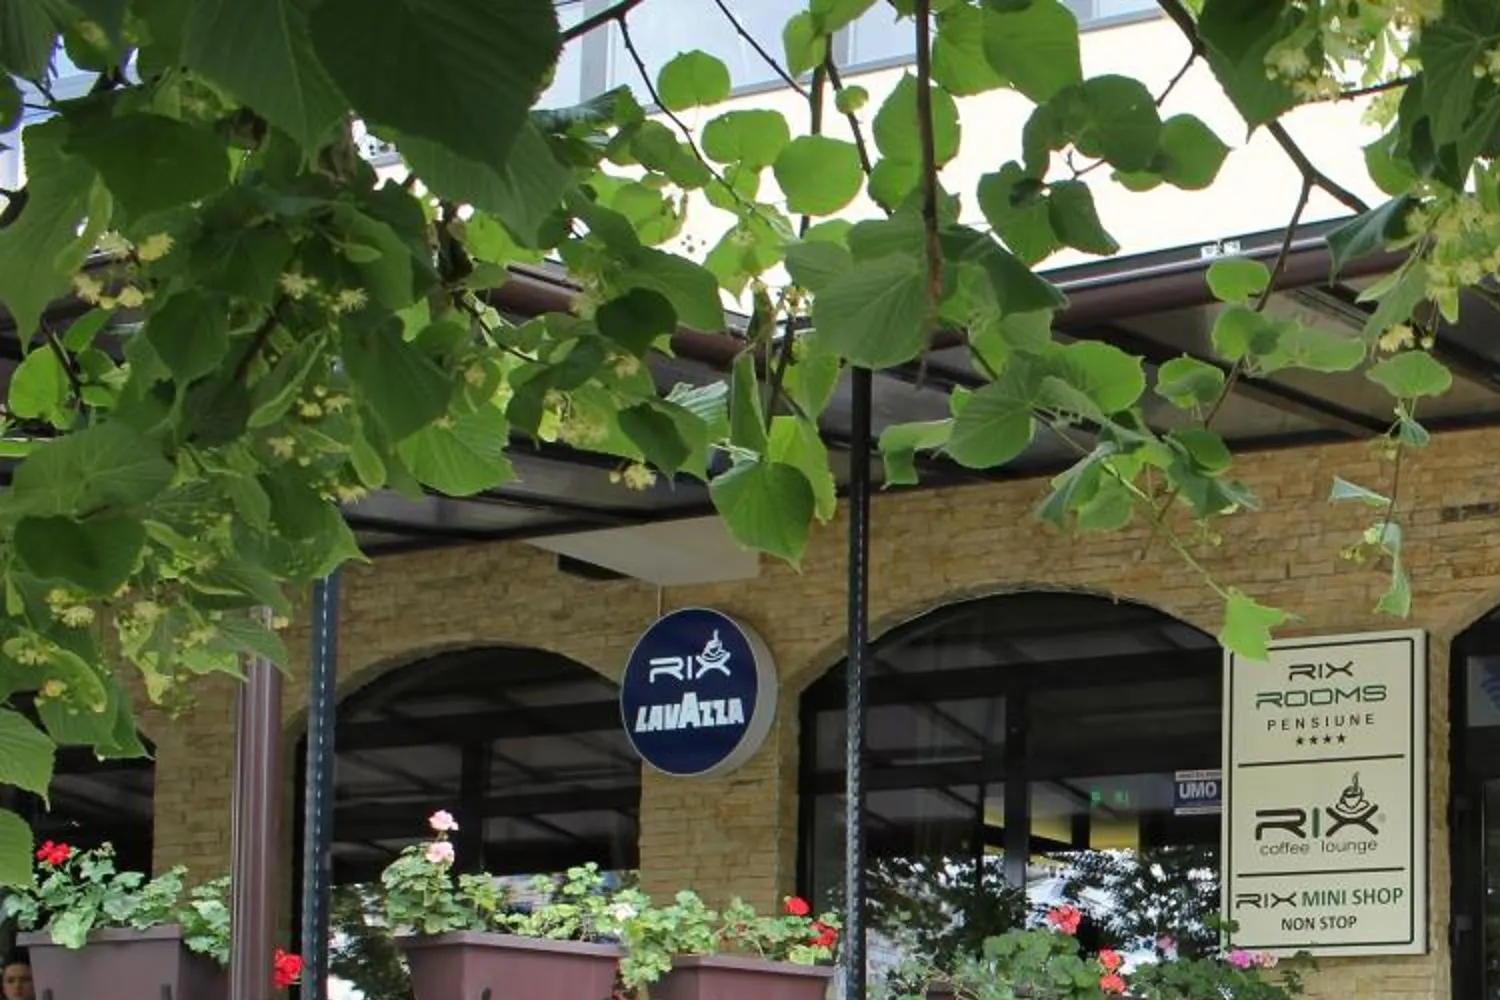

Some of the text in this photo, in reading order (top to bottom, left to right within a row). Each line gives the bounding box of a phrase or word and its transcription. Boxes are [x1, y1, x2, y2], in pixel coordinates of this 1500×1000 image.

[649, 651, 731, 684] RIX
[1289, 660, 1354, 681] RIX
[1255, 685, 1387, 710] ROOMS
[635, 691, 745, 733] LAVAZZA
[1267, 713, 1376, 731] PENSIUNE
[1179, 781, 1217, 799] UMO
[1255, 803, 1379, 841] RIX
[1259, 839, 1378, 856] coffee lounge
[1236, 886, 1404, 910] RIX MINI SHOP
[1281, 915, 1357, 931] NON STOP
